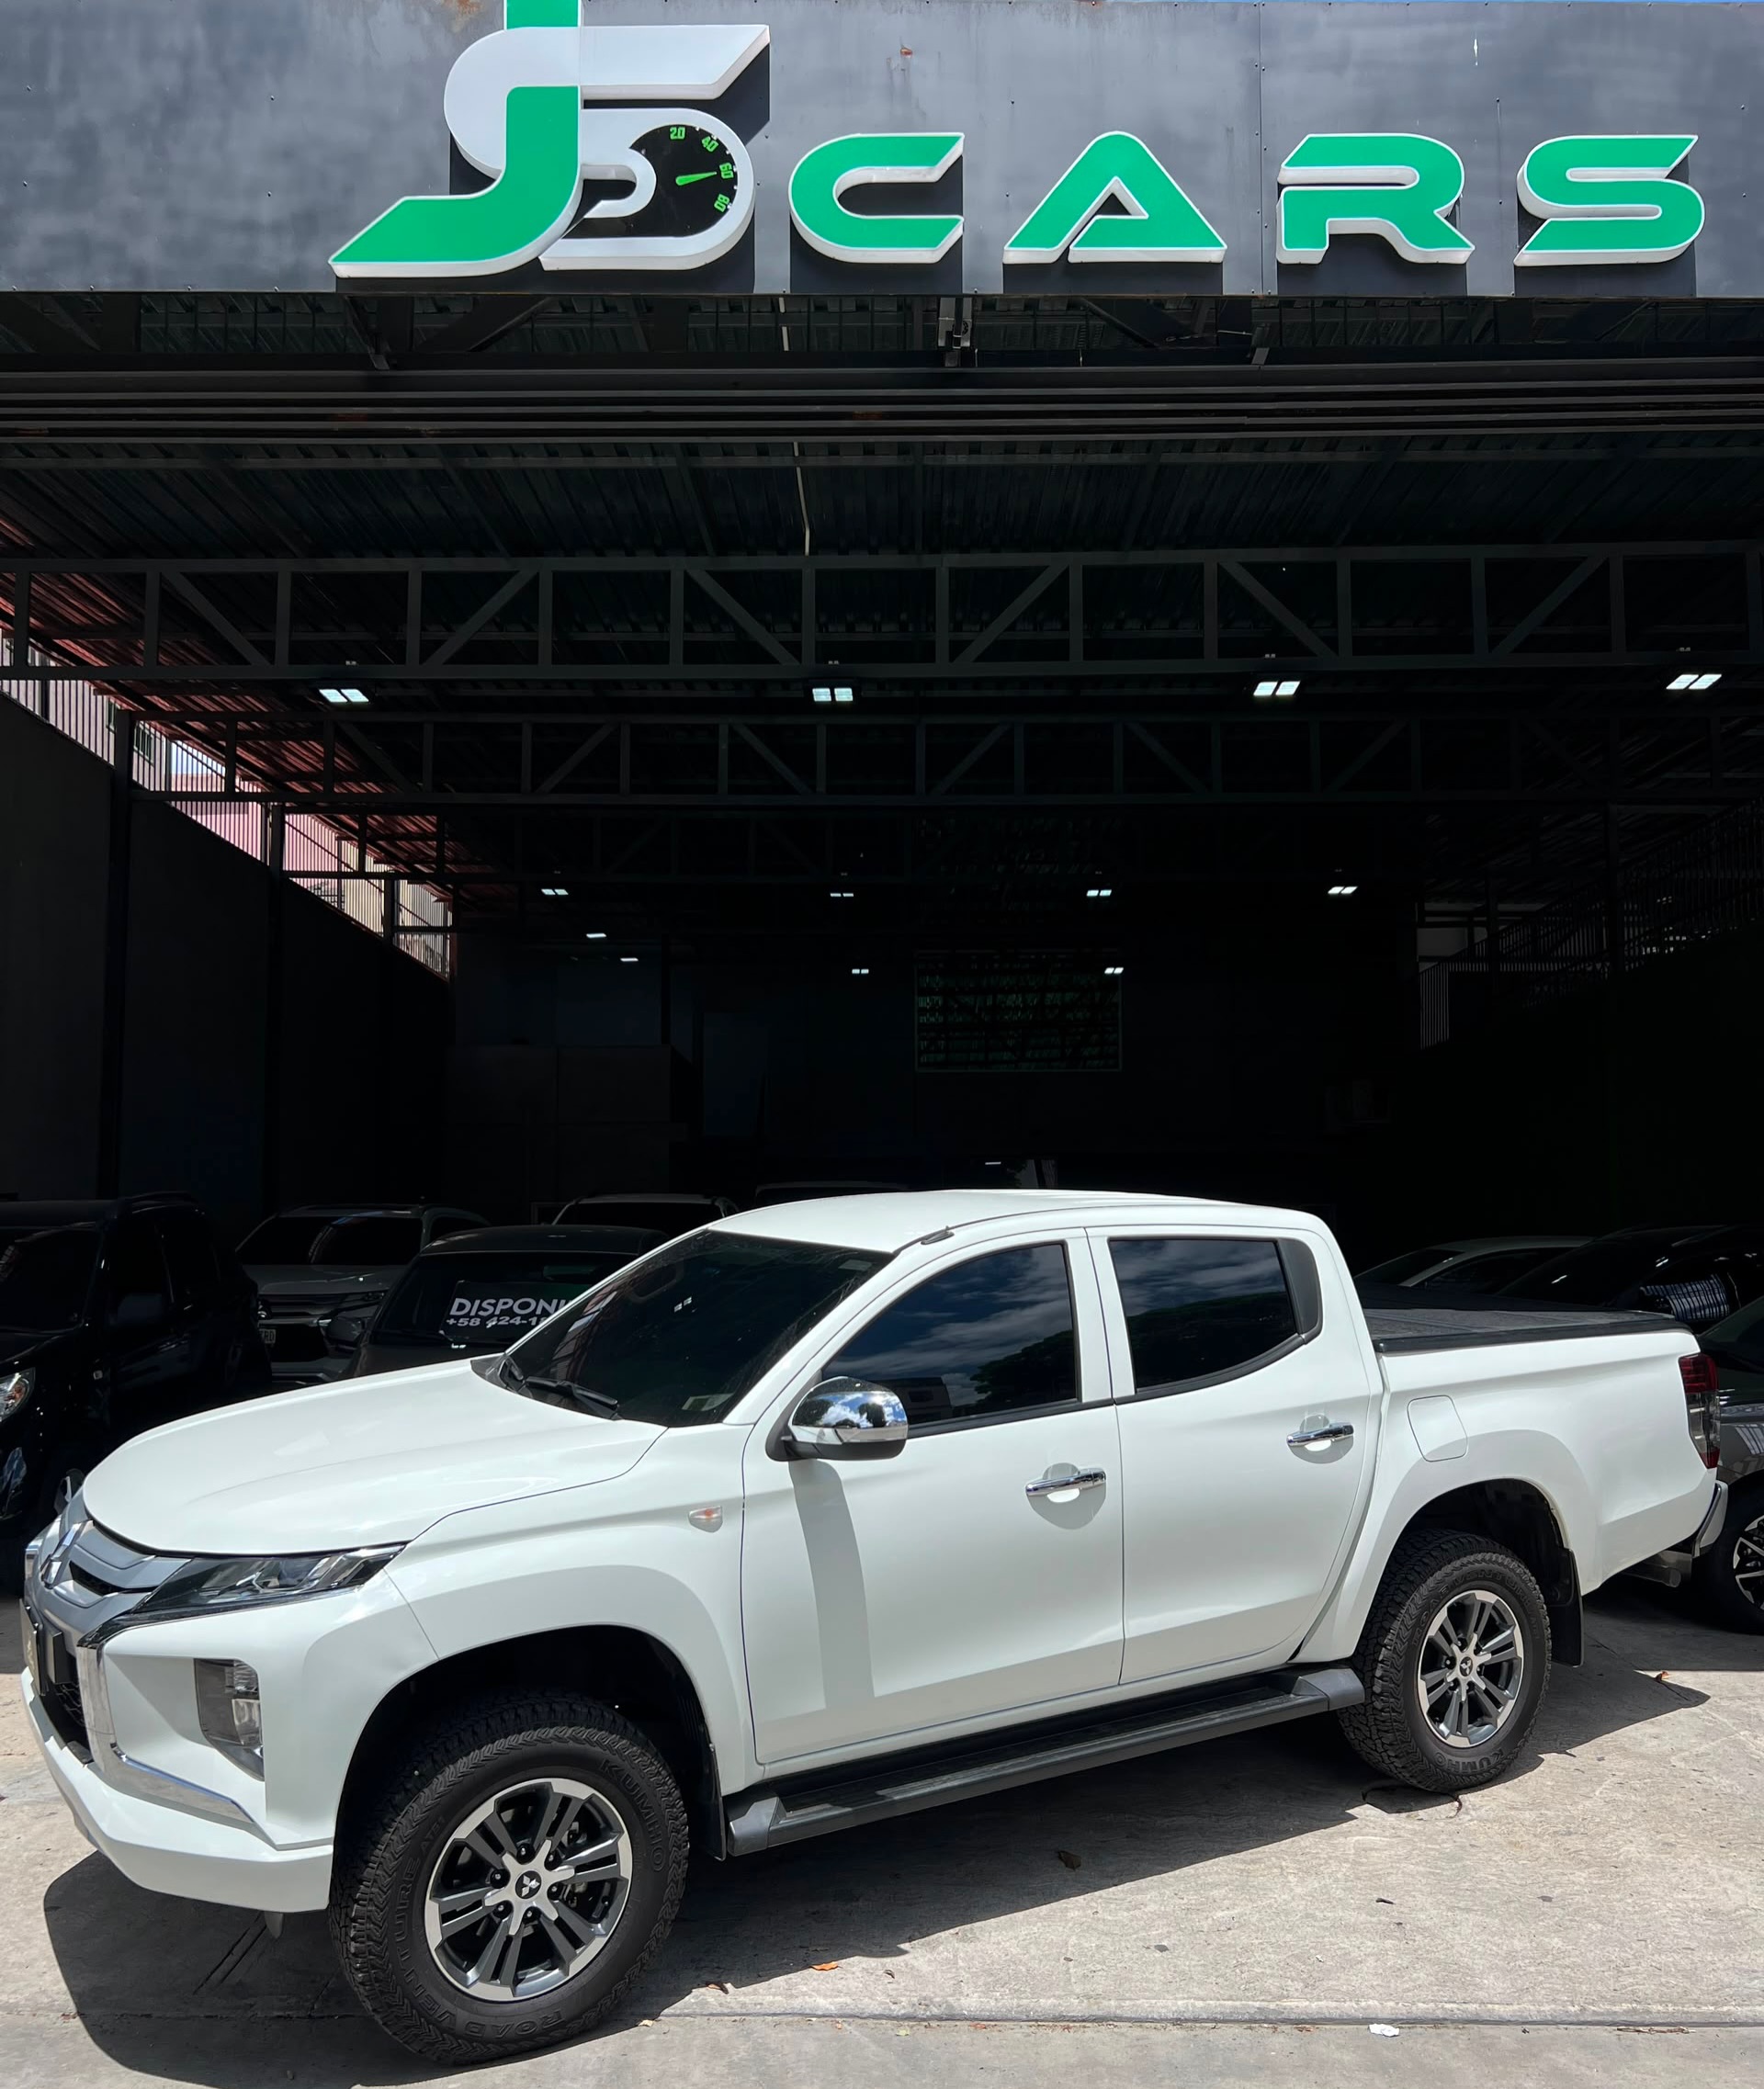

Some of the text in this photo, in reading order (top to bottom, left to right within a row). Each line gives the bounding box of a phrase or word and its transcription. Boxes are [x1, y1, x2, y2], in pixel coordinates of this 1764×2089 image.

[670, 127, 685, 140] 20
[701, 136, 718, 152] 40
[719, 163, 734, 179] 60
[714, 194, 730, 212] 80
[788, 130, 1705, 265] CARS
[449, 1297, 571, 1316] DISPONI
[447, 1316, 481, 1327] +58
[1433, 1747, 1504, 1774] KUMHO
[599, 1758, 665, 1873] KUMHO
[394, 1857, 457, 2031] VENTURE
[464, 2009, 566, 2039] ROAD
